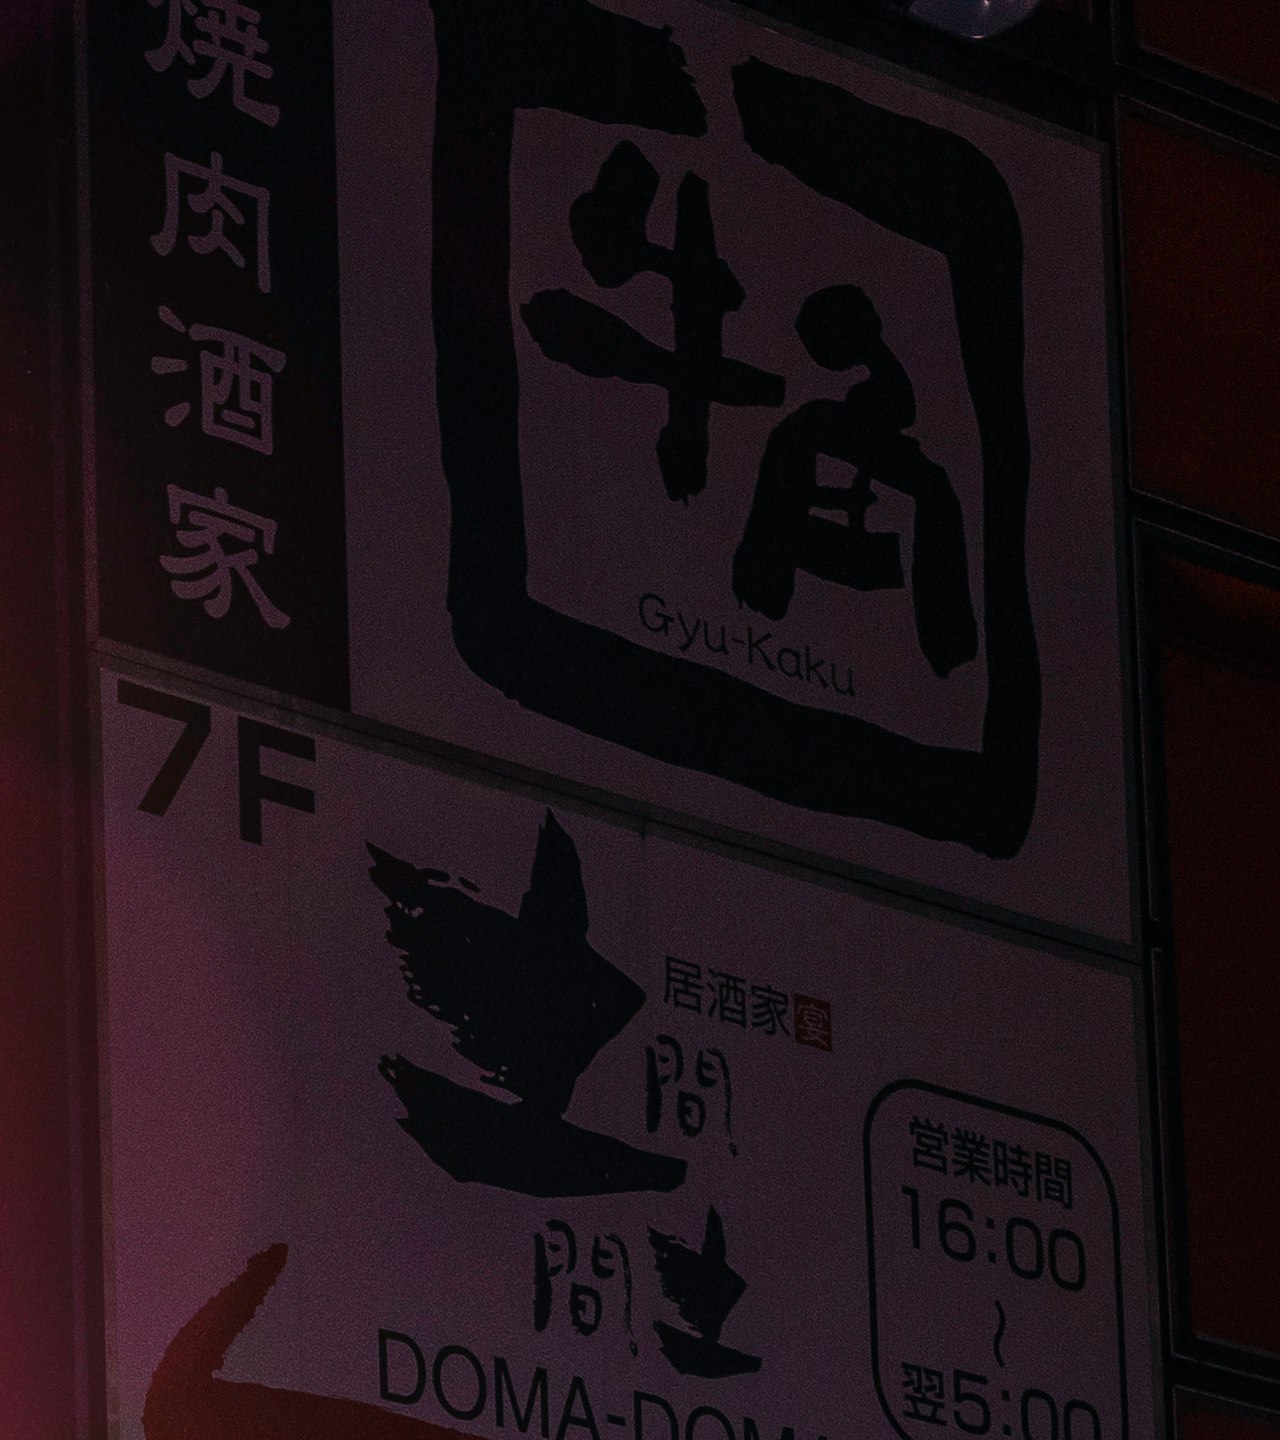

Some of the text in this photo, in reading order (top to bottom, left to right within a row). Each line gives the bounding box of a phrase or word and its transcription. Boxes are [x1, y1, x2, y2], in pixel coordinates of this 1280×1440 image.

[145, 0, 290, 630] 焼肉酒家
[640, 590, 857, 697] Gyu-Kaku
[117, 680, 317, 846] 7F
[909, 1117, 1074, 1208] 営業時間
[900, 1185, 1086, 1293] 16:00
